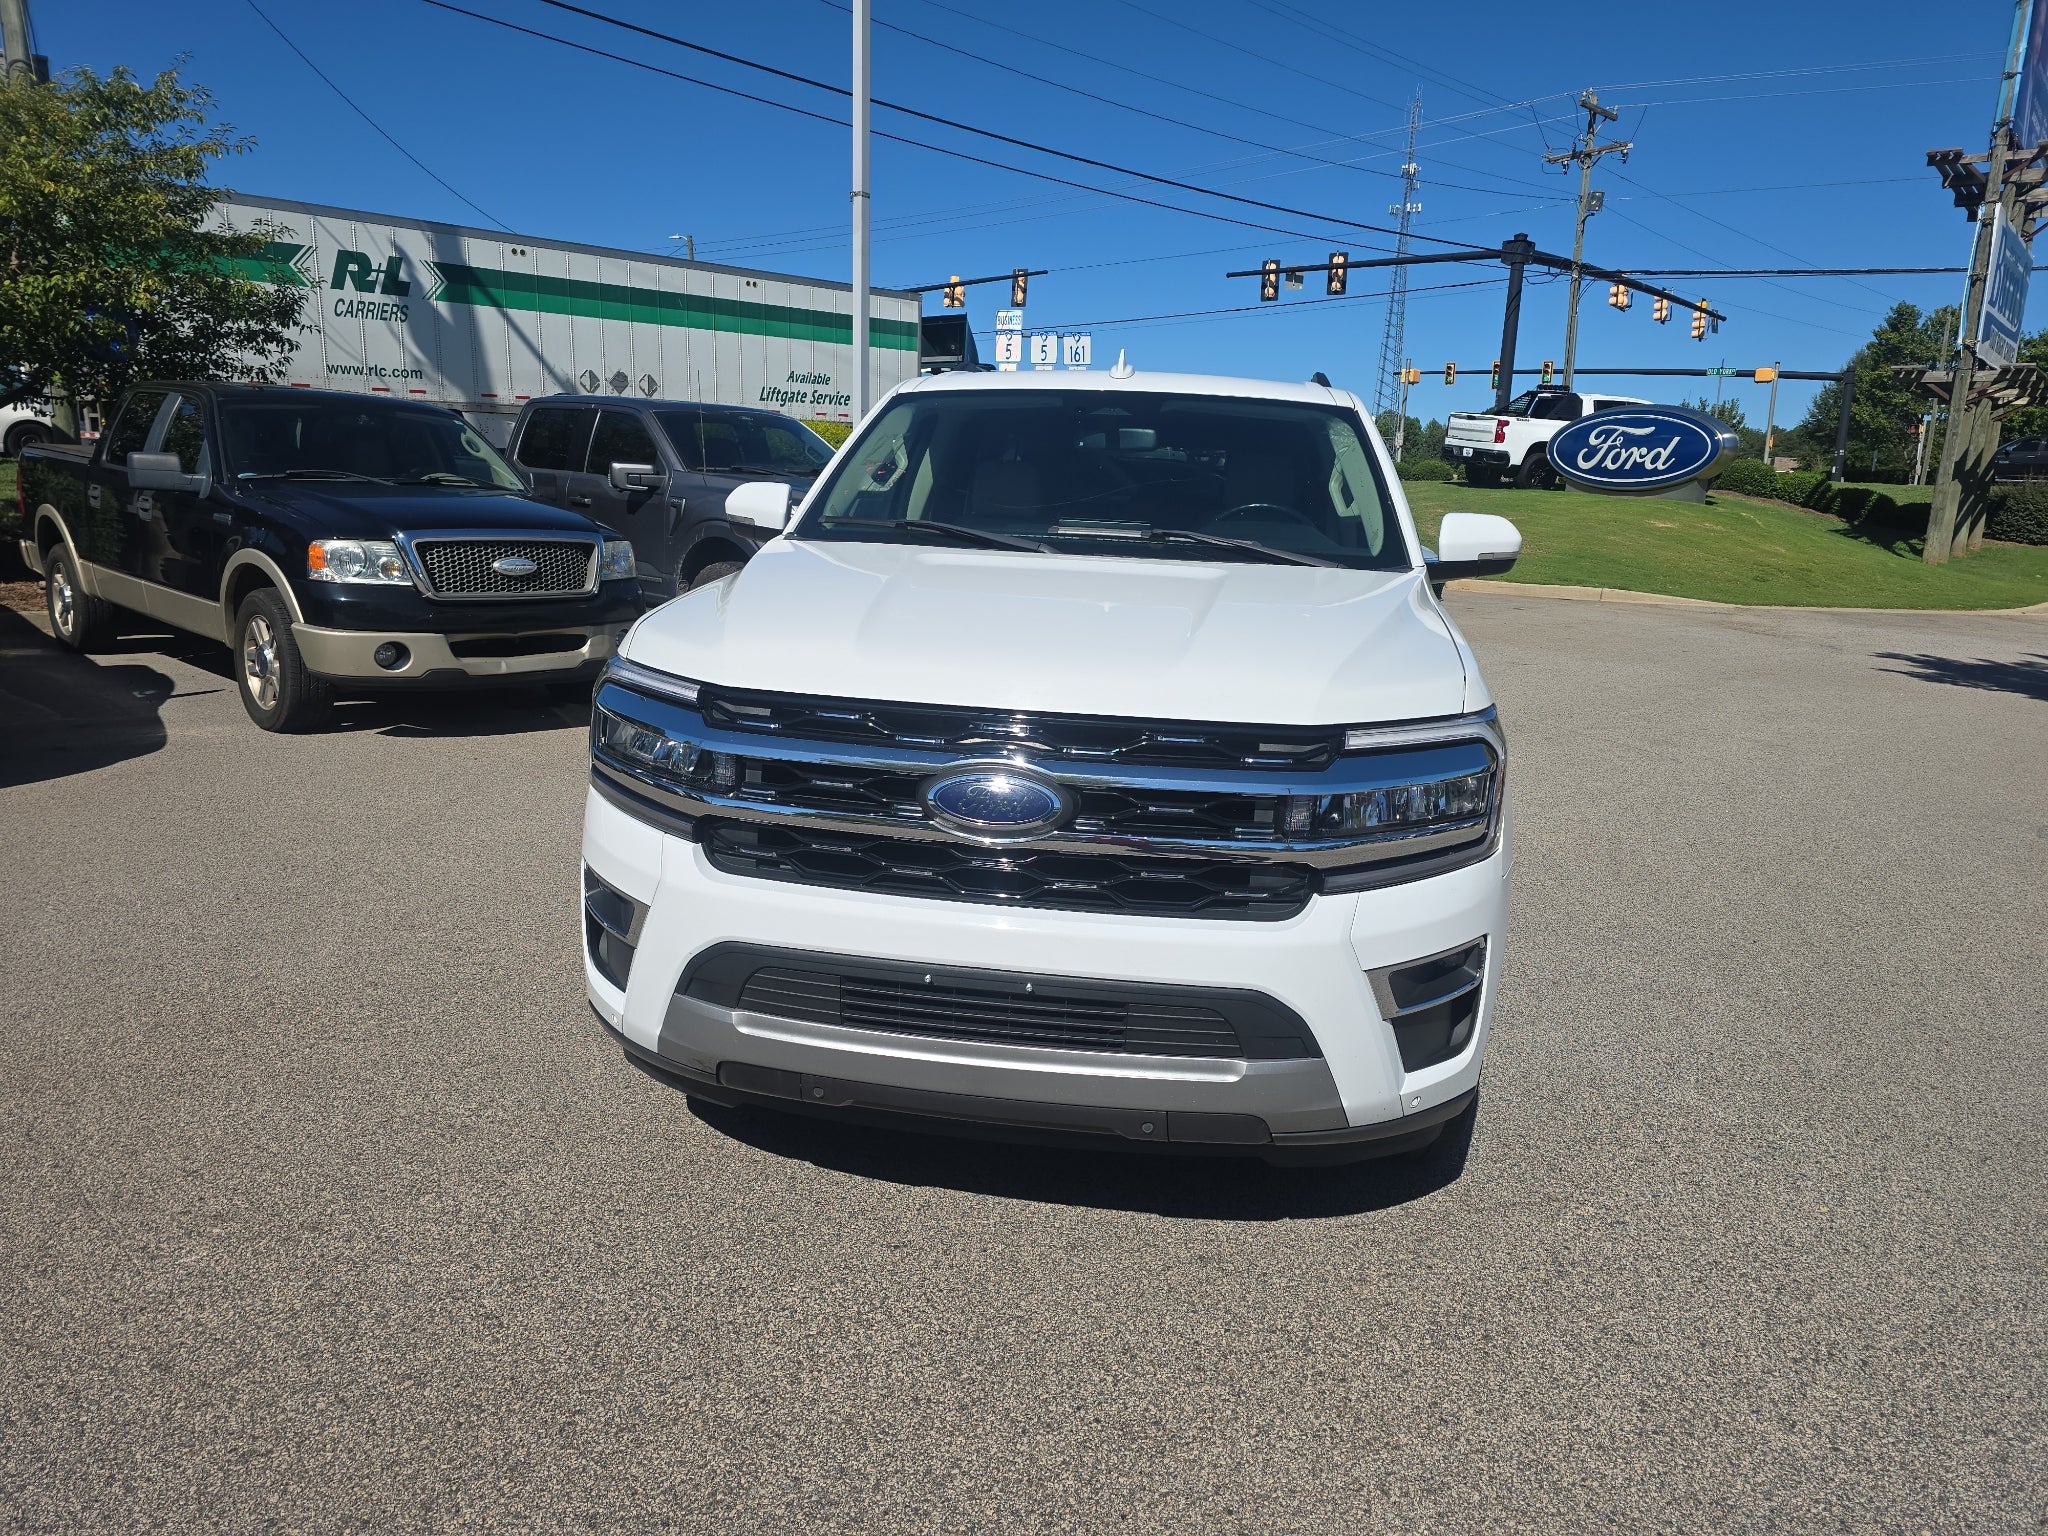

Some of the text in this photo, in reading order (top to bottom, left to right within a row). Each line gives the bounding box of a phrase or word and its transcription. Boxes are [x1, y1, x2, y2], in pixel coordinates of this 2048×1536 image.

[334, 298, 409, 323] CARRIERS
[997, 314, 1022, 326] BUSINESS
[1005, 343, 1012, 360] 5
[1040, 344, 1048, 361] 5
[1069, 345, 1085, 363] 161
[326, 363, 423, 379] www.rlc.com
[787, 370, 831, 386] Available
[759, 386, 851, 407] Liftgate Service
[1577, 425, 1682, 471] Ford
[957, 785, 1029, 818] Ford
